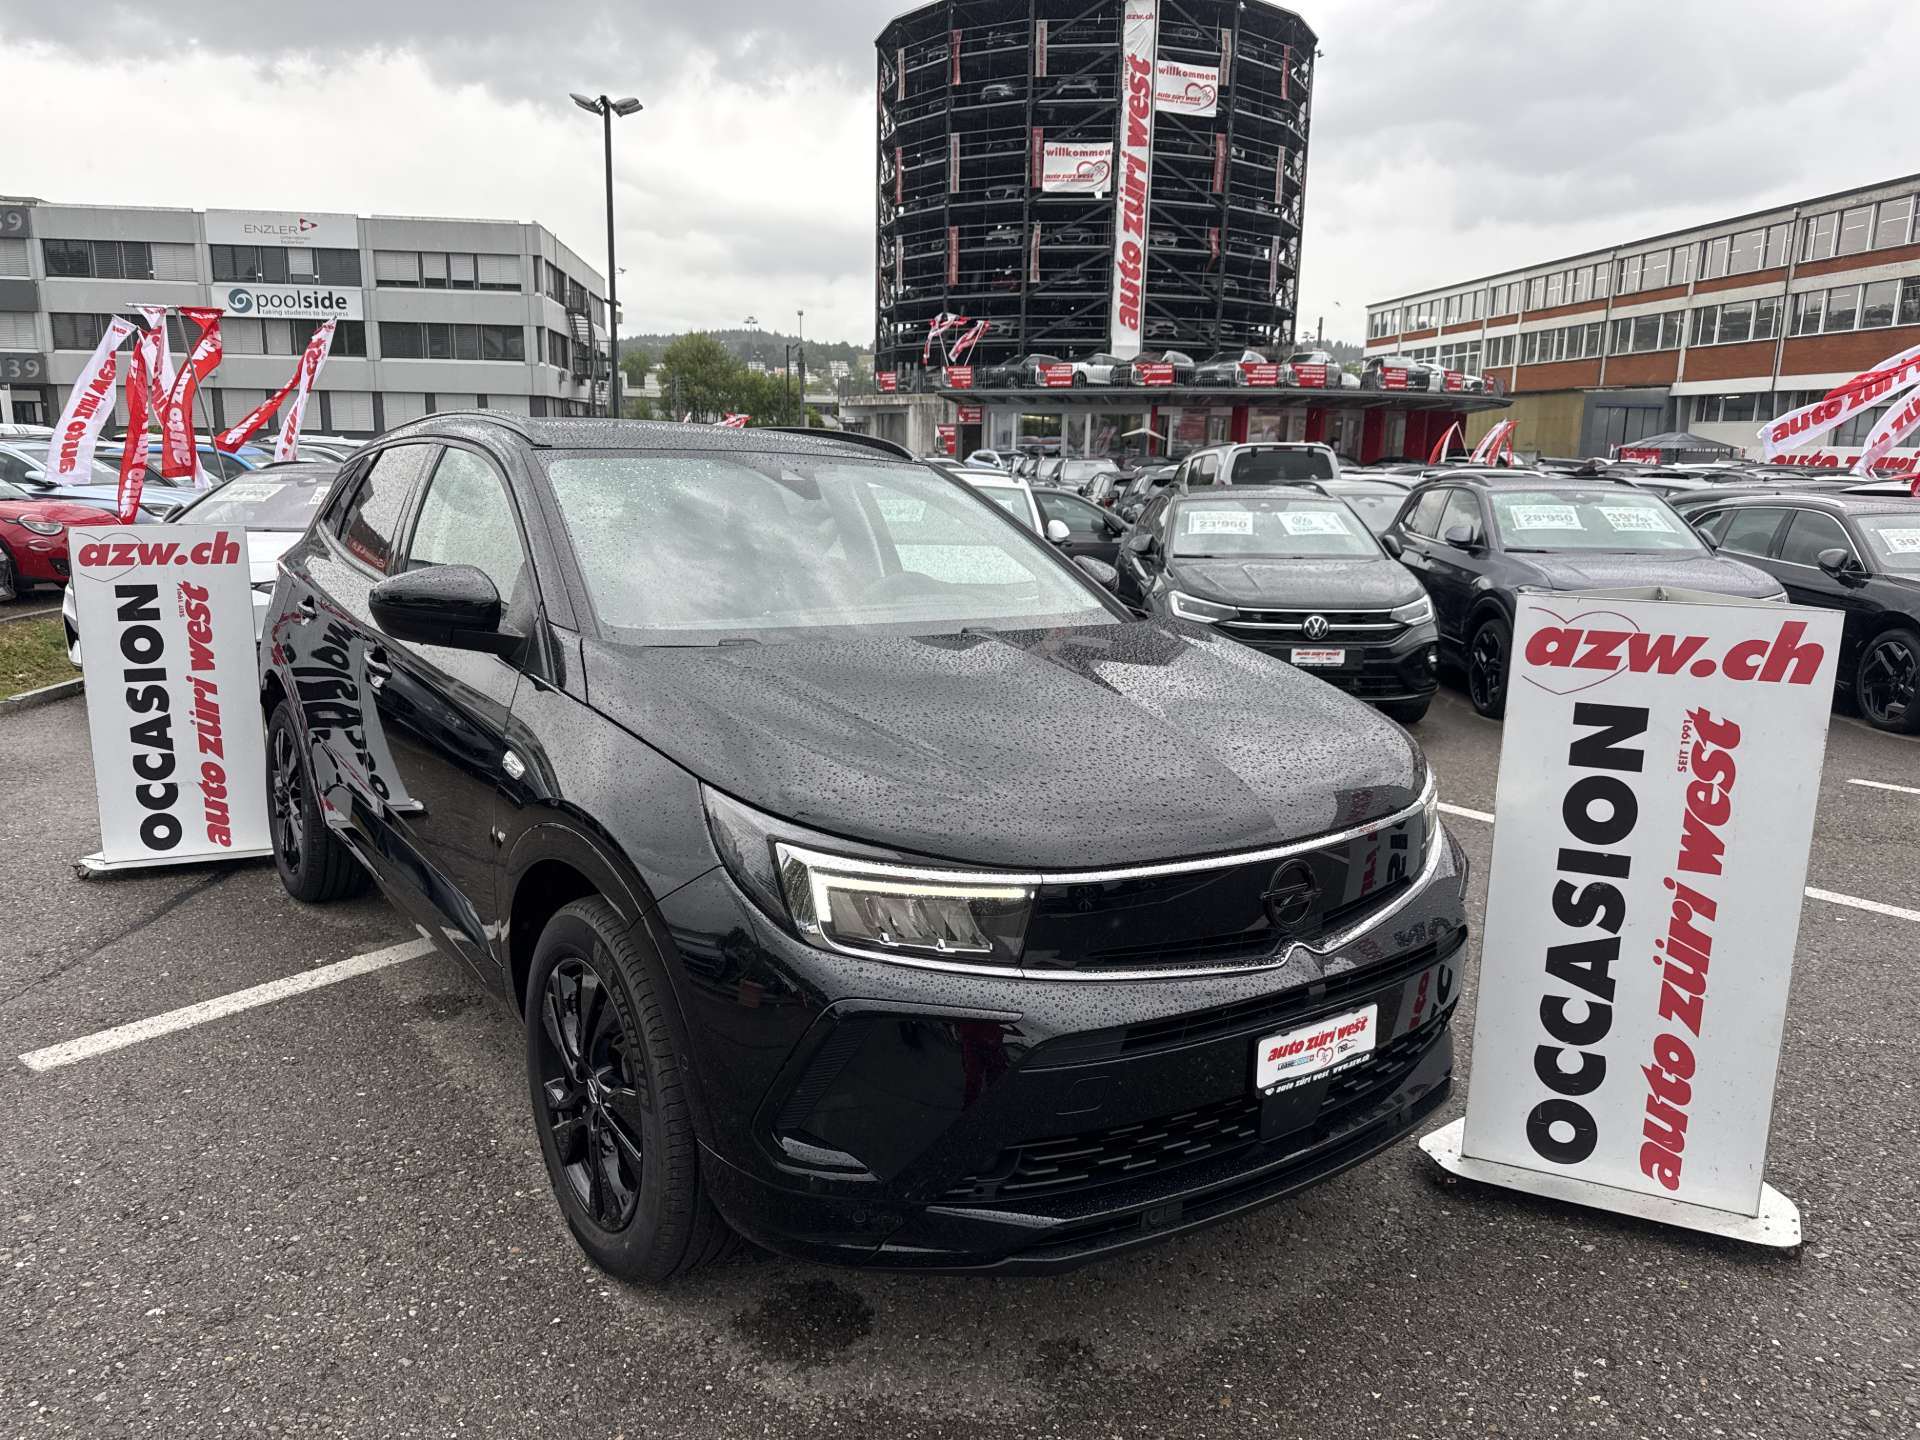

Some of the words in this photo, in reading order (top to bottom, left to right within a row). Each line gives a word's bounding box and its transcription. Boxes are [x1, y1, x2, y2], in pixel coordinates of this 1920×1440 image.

[1126, 53, 1151, 147] west
[1158, 66, 1216, 80] willkommen
[1046, 147, 1110, 157] willkommen
[244, 224, 298, 235] ENZLER
[1120, 150, 1147, 239] züri
[256, 290, 348, 315] poolside
[284, 309, 312, 317] students
[1117, 240, 1142, 331] auto
[167, 407, 192, 468] auto
[1771, 400, 1843, 443] auto
[78, 531, 240, 567] azw.ch
[177, 580, 216, 671] west
[1525, 621, 1825, 685] azw.ch
[114, 583, 183, 851] OCCASION
[185, 675, 225, 761] züri
[1680, 719, 1693, 745] 1991
[1677, 748, 1689, 773] SEIT
[1677, 706, 1741, 876] west
[197, 761, 232, 848] auto
[1526, 701, 1651, 1165] OCCASION
[1653, 877, 1718, 1038] züri
[613, 984, 650, 1107] MICHELIN
[1268, 1041, 1304, 1062] auto
[1305, 1027, 1337, 1051] züri
[1337, 1017, 1368, 1040] west
[1639, 1032, 1697, 1191] auto
